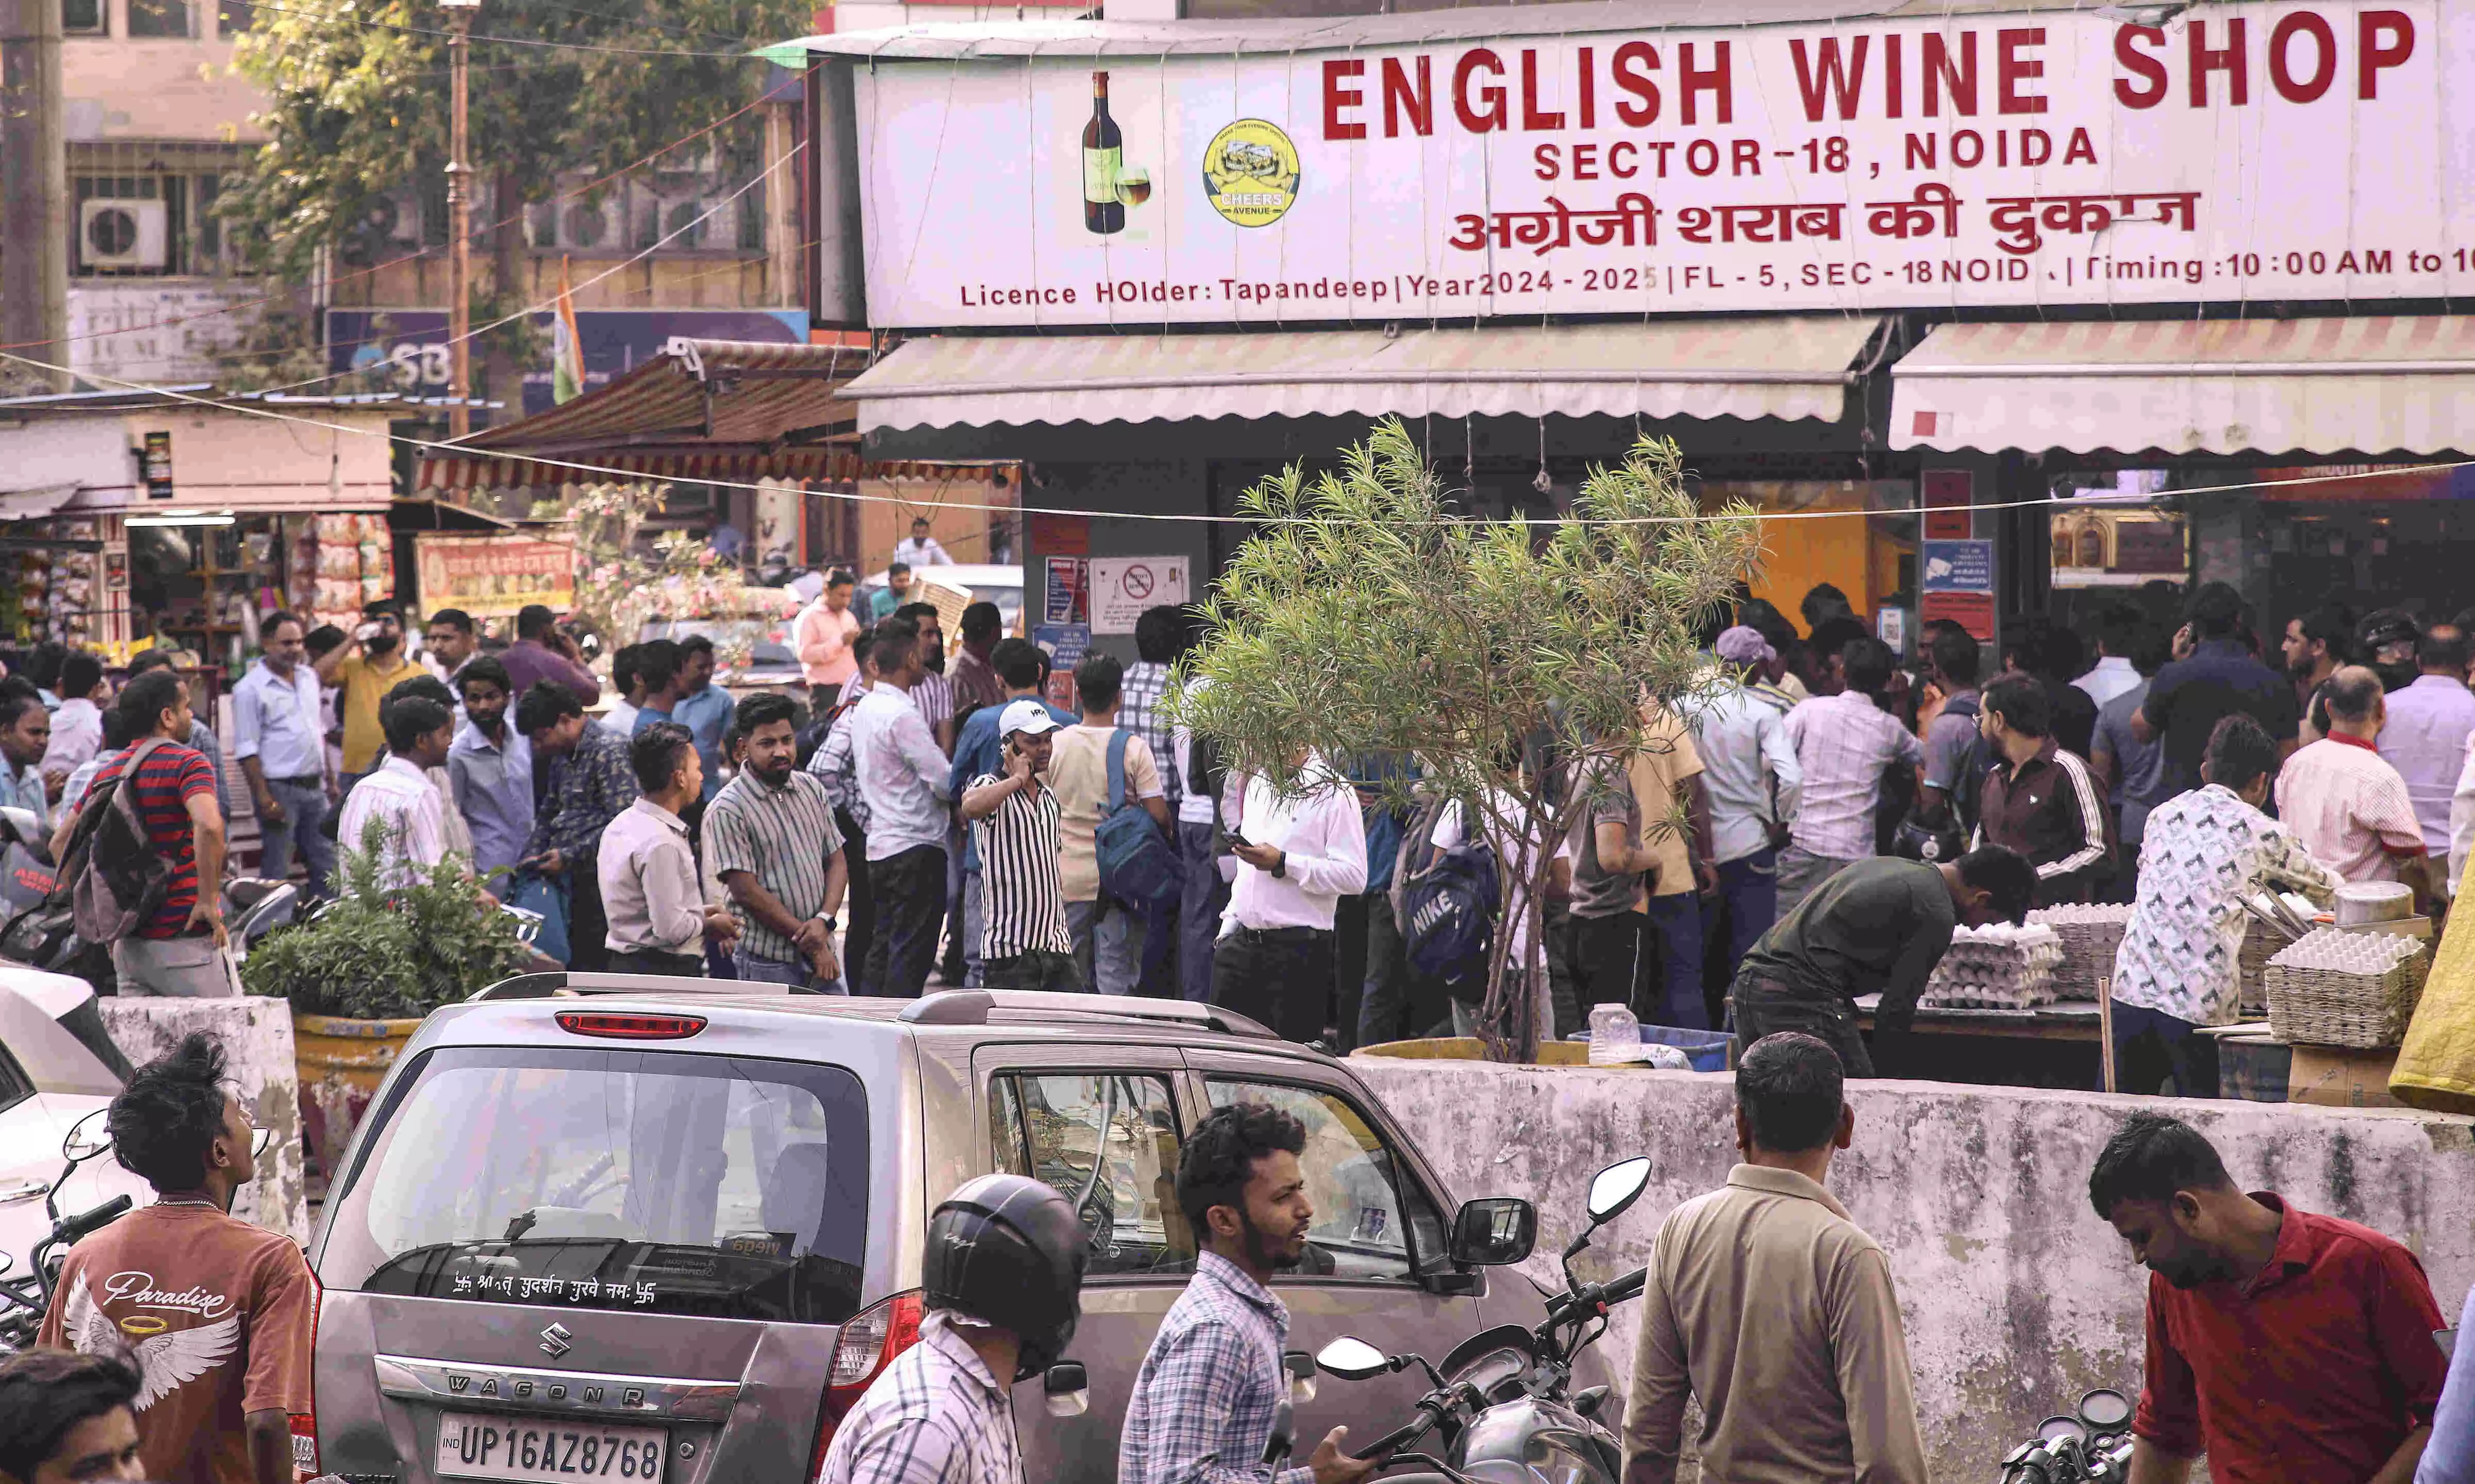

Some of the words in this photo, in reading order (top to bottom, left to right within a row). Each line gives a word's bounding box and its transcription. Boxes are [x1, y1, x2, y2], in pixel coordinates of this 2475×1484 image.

[1323, 41, 1733, 141] ENGLISH
[1789, 27, 2048, 122] WINE
[2114, 10, 2416, 109] SHOP
[1906, 127, 2098, 170] NOIDA
[1220, 193, 1283, 206] CHEERS
[1677, 203, 1847, 243] शराब
[1864, 182, 1965, 239] की
[961, 287, 1076, 306] Licence
[2408, 251, 2443, 273] to
[2453, 248, 2474, 272] 1
[1413, 890, 1453, 936] NIKE
[103, 1271, 236, 1319] Paradise
[605, 1282, 631, 1299] नमः
[442, 1438, 459, 1449] IND
[460, 1426, 659, 1479] UP16AZ8768
